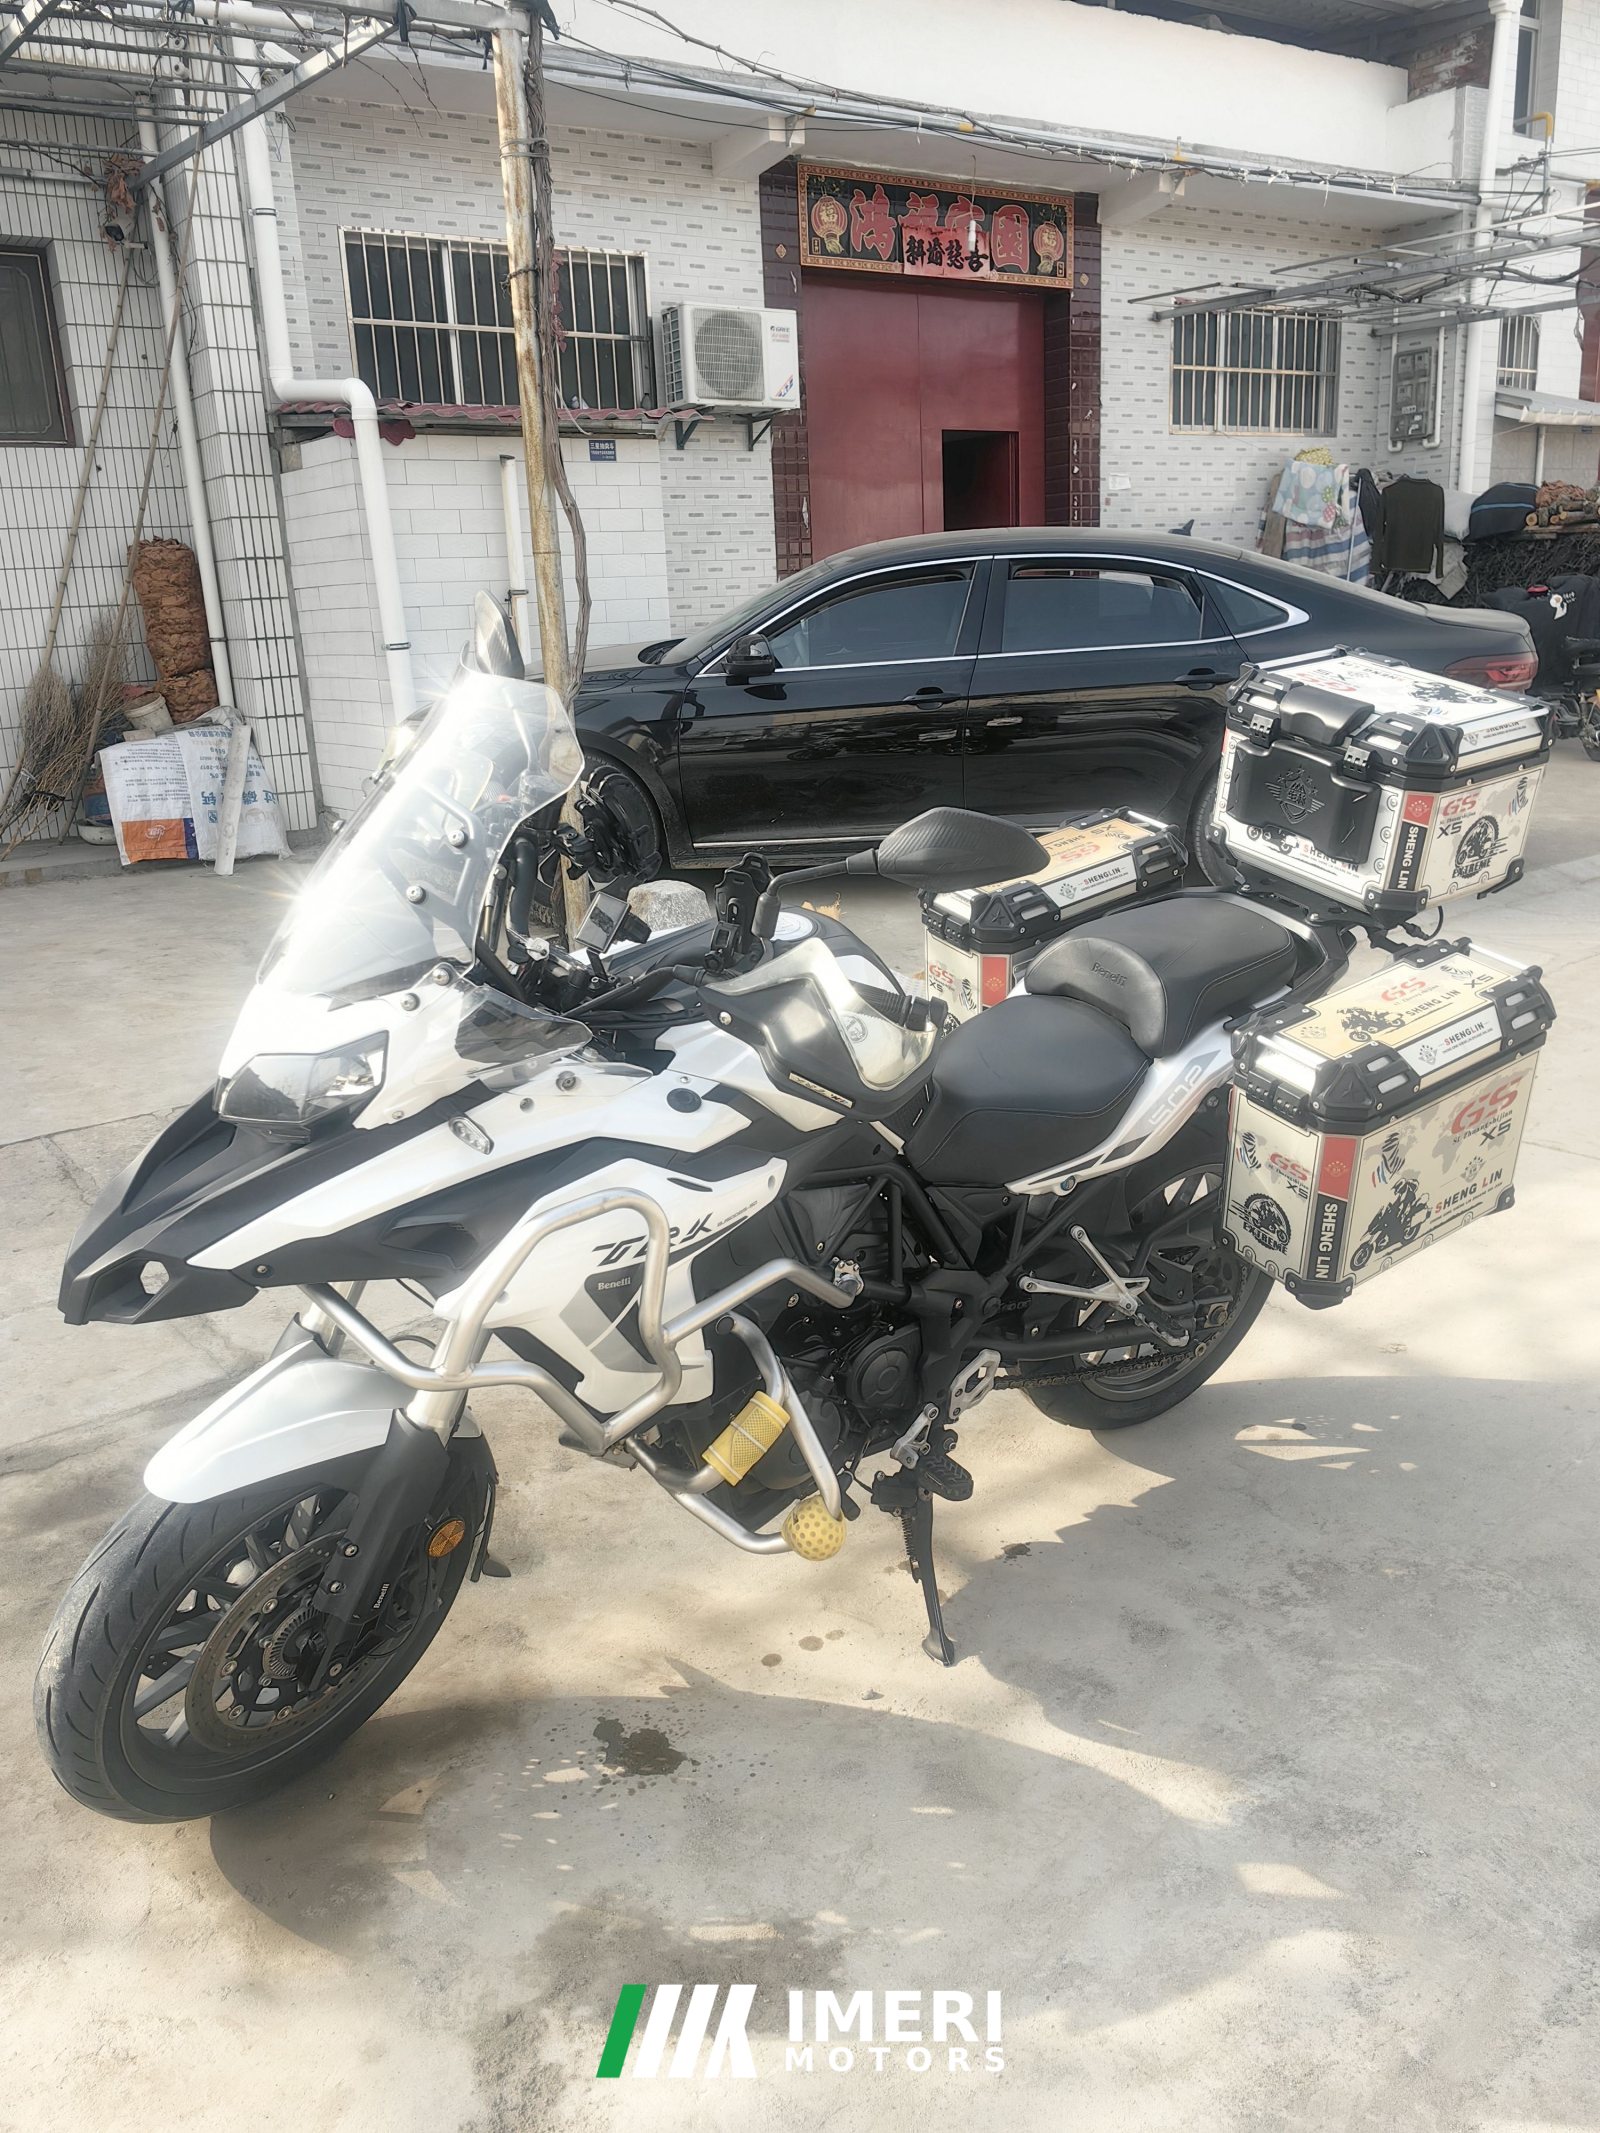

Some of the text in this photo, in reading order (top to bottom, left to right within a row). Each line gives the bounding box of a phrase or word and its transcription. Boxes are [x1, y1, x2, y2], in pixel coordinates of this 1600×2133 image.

[819, 204, 838, 223] 福
[1041, 229, 1057, 247] 福
[201, 789, 277, 806] 过磷钙
[1442, 792, 1480, 818] GS
[1396, 826, 1419, 889] SHENG LIN
[1083, 866, 1122, 886] SHENGLIN
[1091, 961, 1128, 987] Benelli
[1464, 973, 1495, 990] X5
[1380, 977, 1426, 1003] GS
[1405, 989, 1461, 1017] SHENG LIN
[1444, 1021, 1485, 1047] SHENGLIN
[1451, 1076, 1523, 1135] GS
[1479, 1122, 1513, 1146] X5
[1269, 1151, 1312, 1182] GS
[1285, 1181, 1310, 1200] X5
[1434, 1182, 1478, 1214] SHENG
[1482, 1168, 1504, 1190] LIN
[1242, 1222, 1288, 1256] EXTREME
[1315, 1201, 1338, 1279] SHENG LIN
[597, 1276, 632, 1291] Benelli
[373, 1583, 390, 1609] Benelli
